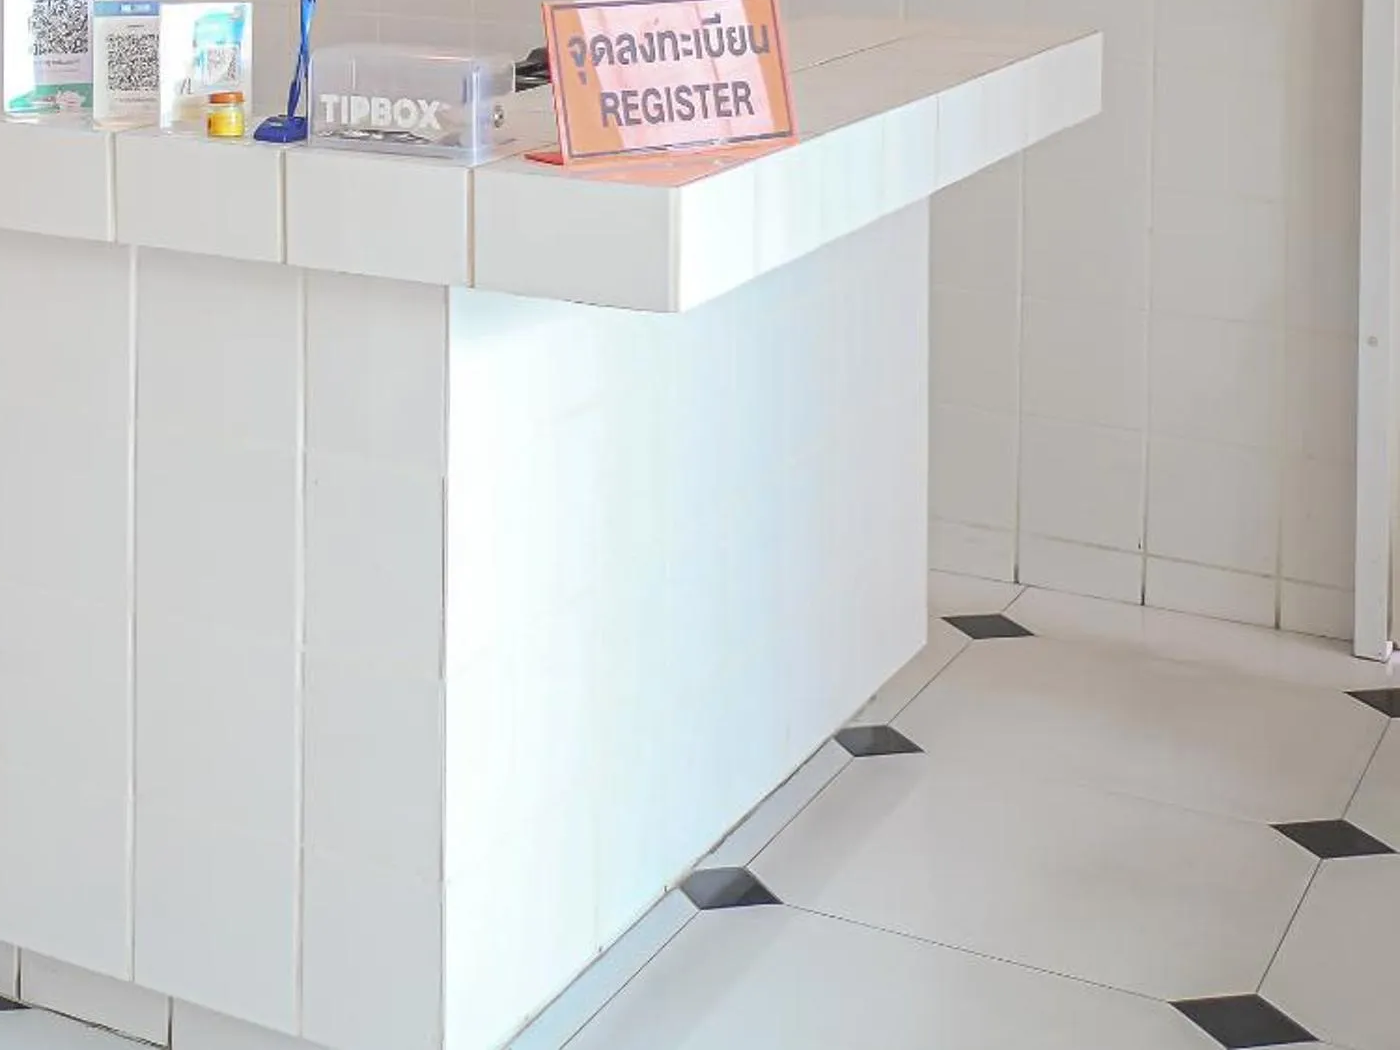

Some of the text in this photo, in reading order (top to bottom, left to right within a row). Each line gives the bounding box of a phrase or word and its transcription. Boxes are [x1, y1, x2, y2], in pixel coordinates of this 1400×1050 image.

[567, 12, 772, 86] จุดลงทะเบียน
[600, 80, 756, 128] REGISTER
